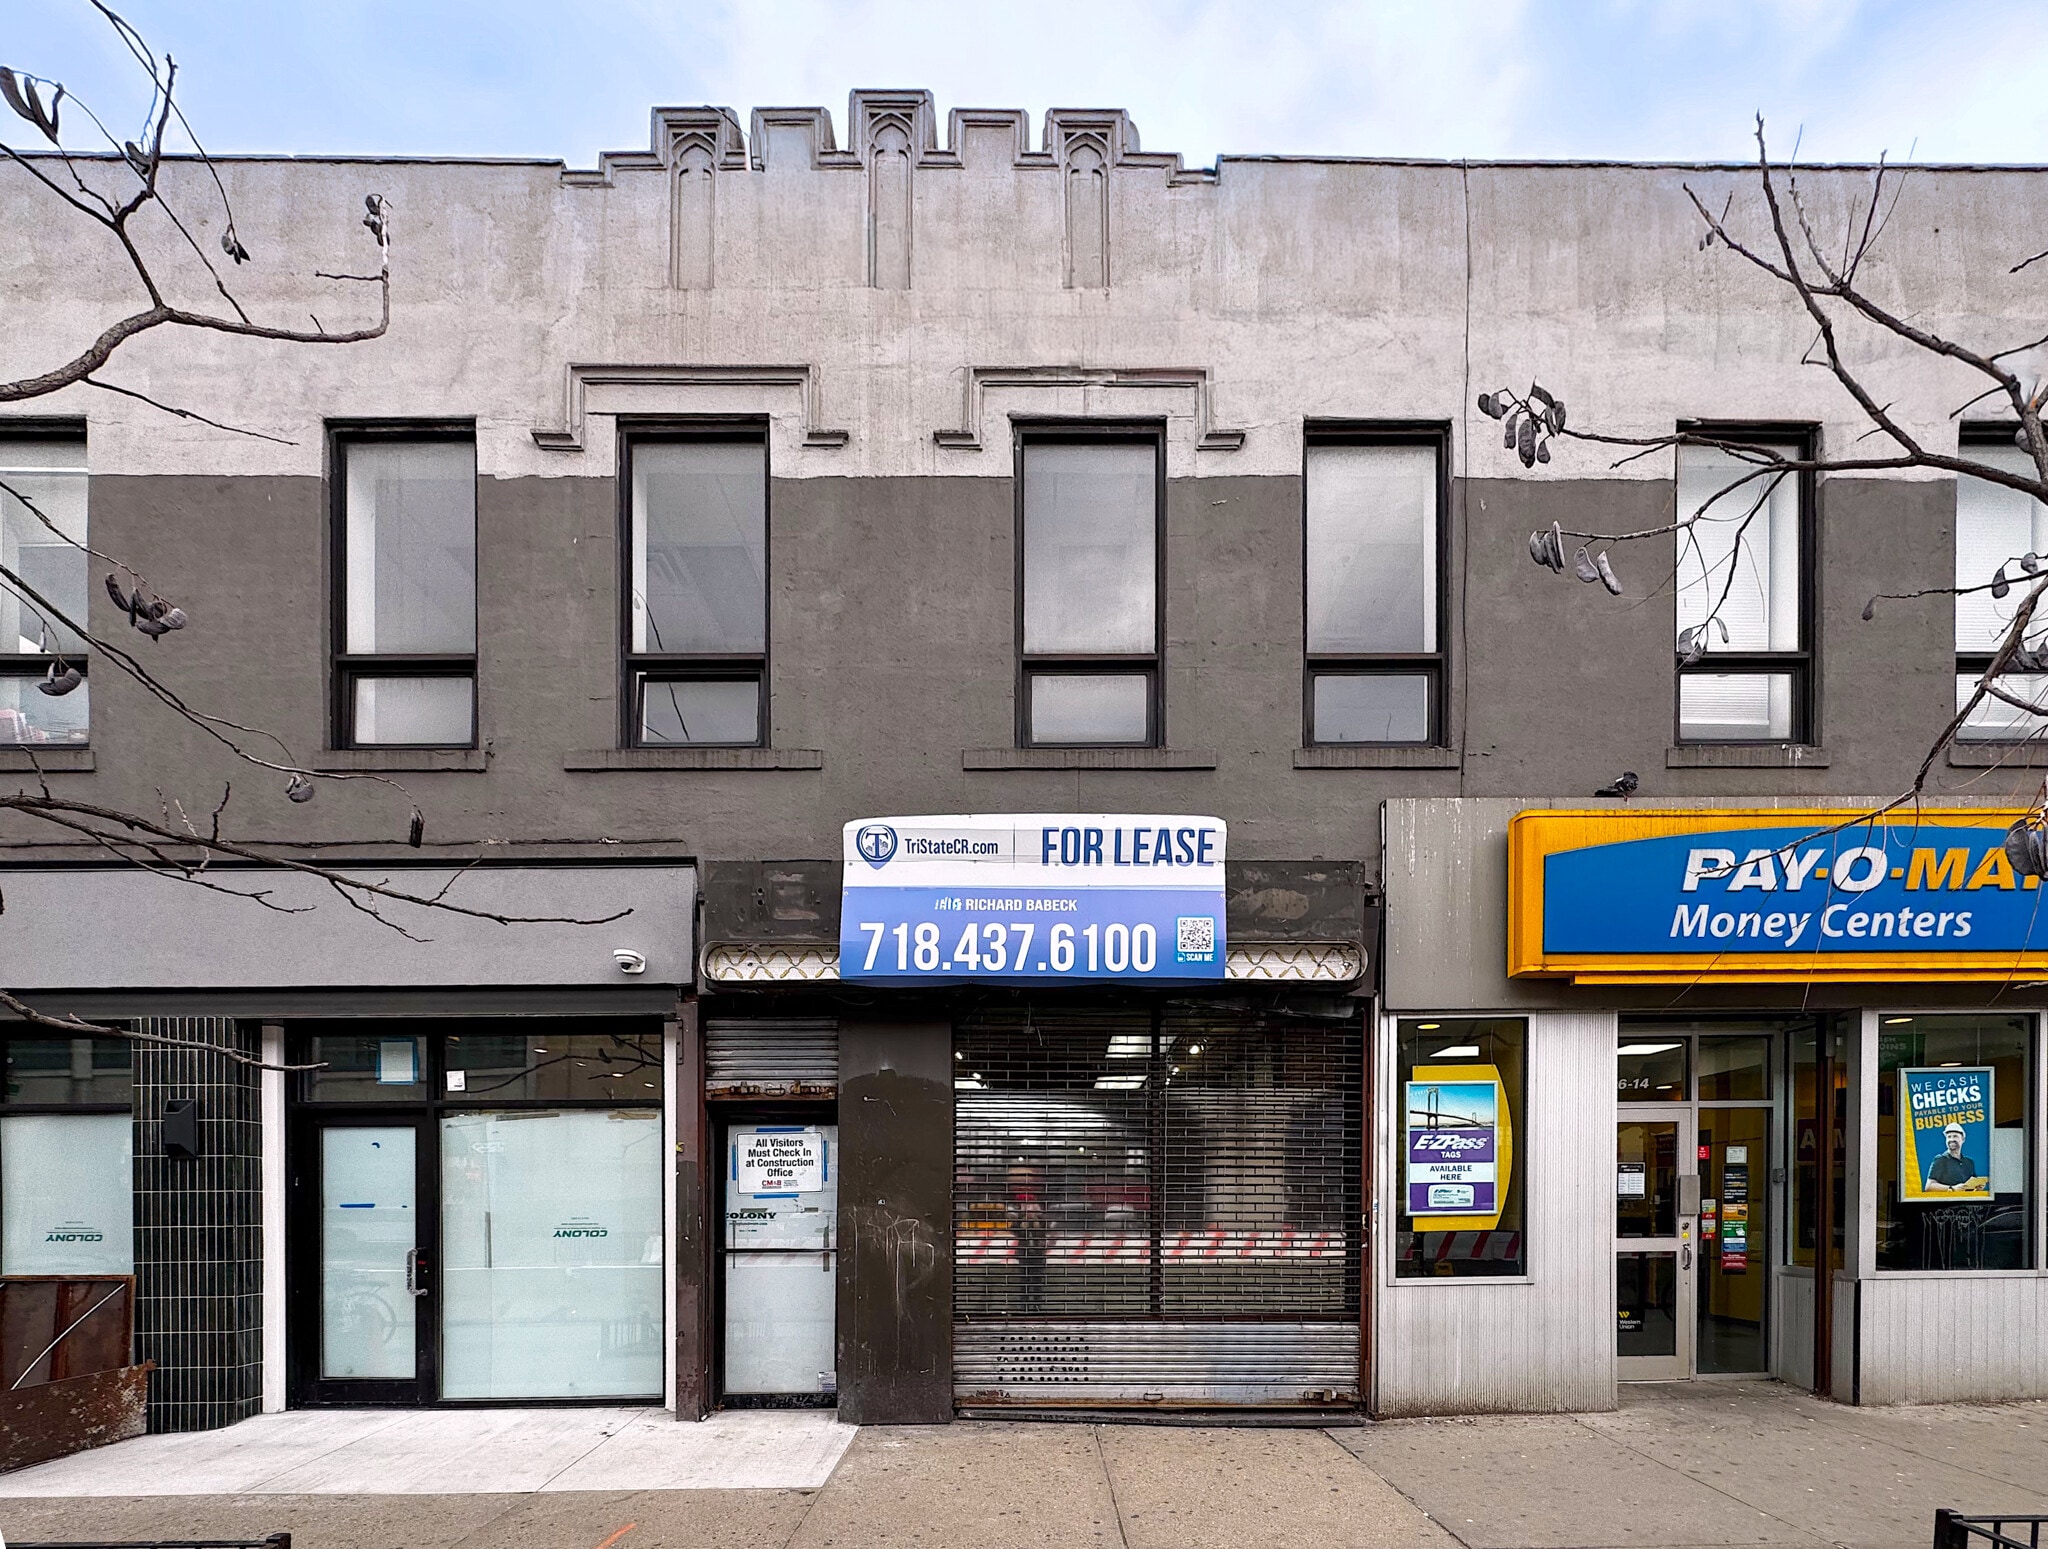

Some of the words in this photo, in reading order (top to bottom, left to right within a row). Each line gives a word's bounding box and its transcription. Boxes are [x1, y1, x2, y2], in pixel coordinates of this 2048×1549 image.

[905, 837, 998, 855] TriStateCR.com
[1042, 827, 1104, 867] FOR
[1115, 827, 1216, 867] LEASE
[965, 898, 1023, 911] RICHARD
[1025, 899, 1078, 911] BABECK
[1670, 904, 1810, 947] Money
[1819, 903, 1972, 938] Centers
[859, 922, 1157, 973] 718.437.6100
[1186, 953, 1203, 962] SCAN
[1203, 953, 1214, 962] ME
[1911, 1081, 1933, 1093] WE
[1937, 1075, 1979, 1090] CASH
[1912, 1085, 1982, 1110] CHECKS
[1914, 1107, 1946, 1117] PAYABLE
[1961, 1102, 1983, 1111] YOUR
[1915, 1108, 1985, 1131] BUSINESS
[755, 1139, 768, 1148] All
[769, 1138, 803, 1148] Visitors
[748, 1148, 771, 1158] Must
[772, 1148, 801, 1158] Check
[803, 1148, 812, 1157] In
[745, 1159, 755, 1167] at
[757, 1158, 814, 1167] Construction
[767, 1168, 793, 1177] Office
[45, 1234, 103, 1242] COLONY
[553, 1230, 608, 1238] COLONY
